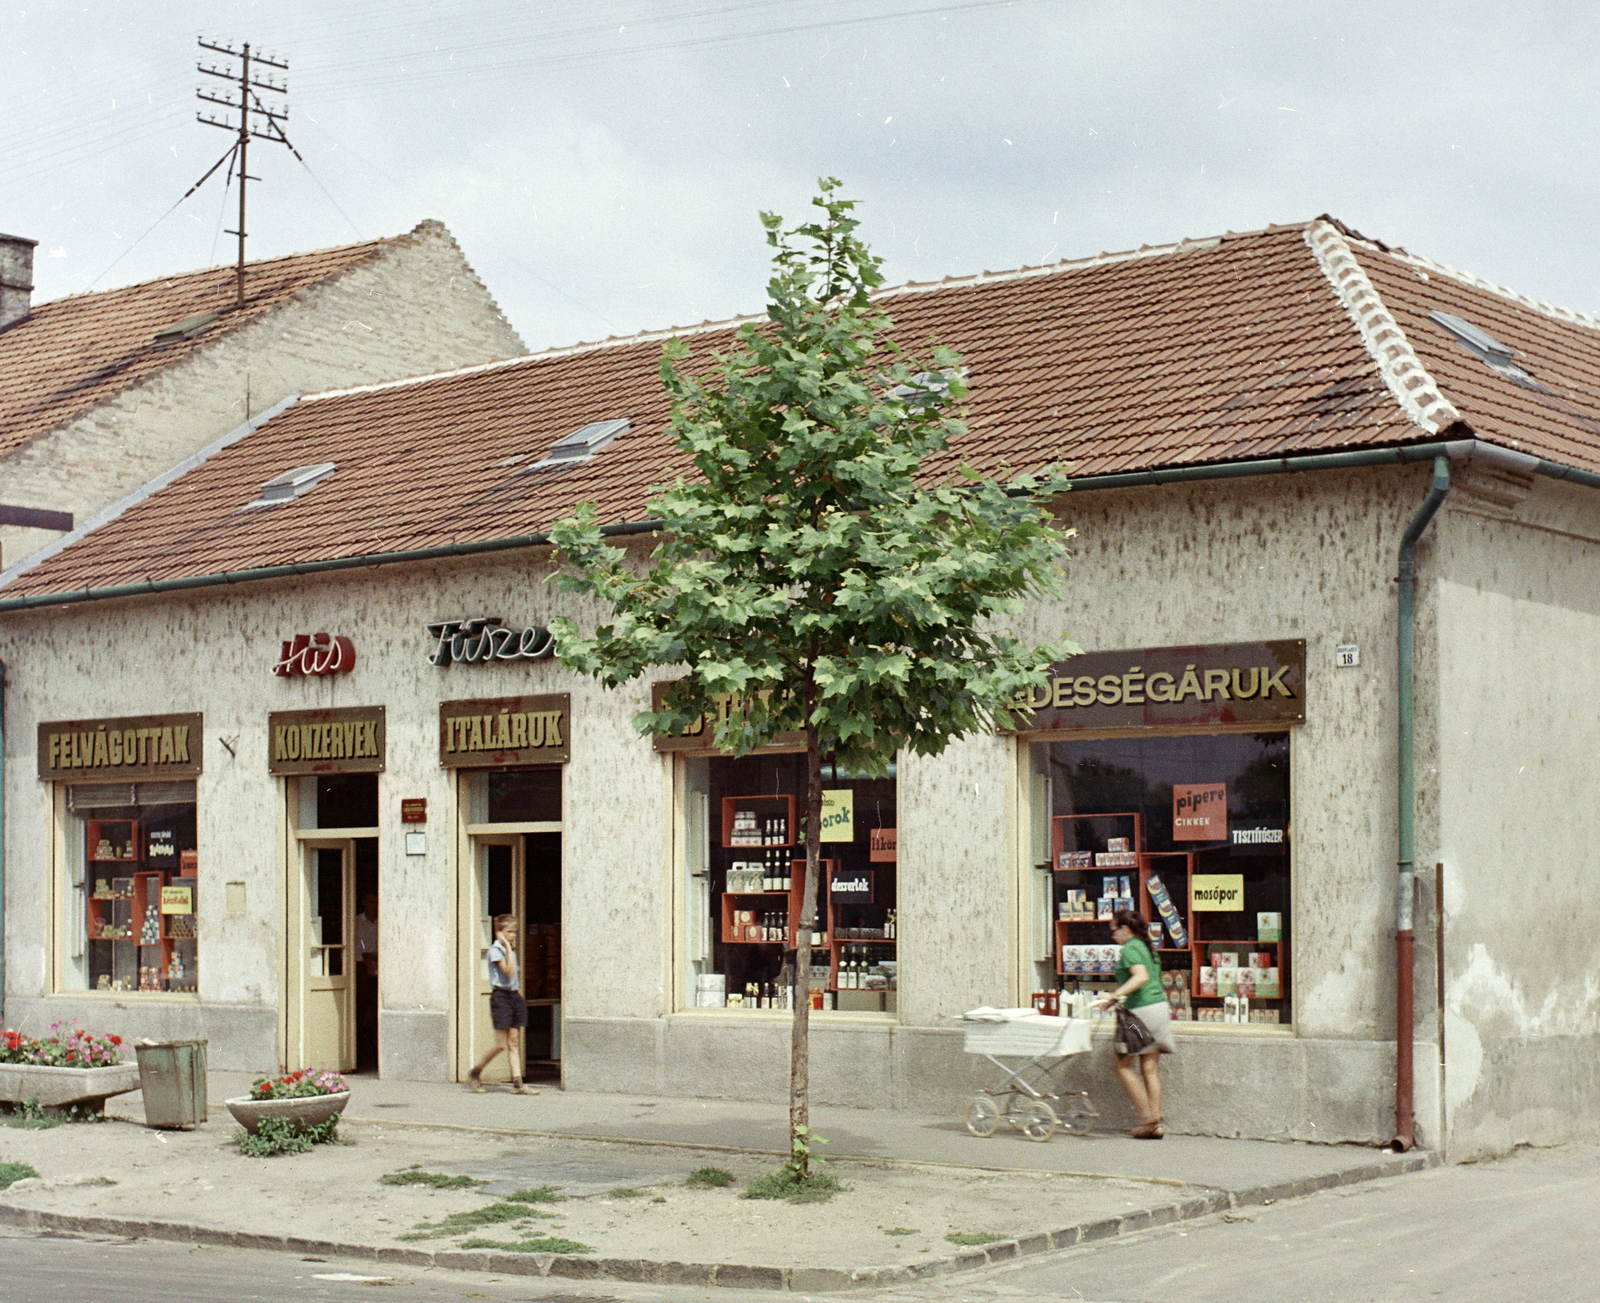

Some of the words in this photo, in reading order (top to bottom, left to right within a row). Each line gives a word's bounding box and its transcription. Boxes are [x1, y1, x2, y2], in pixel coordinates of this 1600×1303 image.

[1342, 653, 1354, 665] 18
[275, 720, 379, 762] KONZERVEK
[446, 708, 563, 753] ITALÁRUK
[50, 725, 191, 770] FELVÁGOTTAK
[1176, 789, 1225, 816] pipere
[822, 807, 851, 828] orok
[1175, 817, 1210, 826] CIKKEK
[1194, 886, 1238, 904] mosópor
